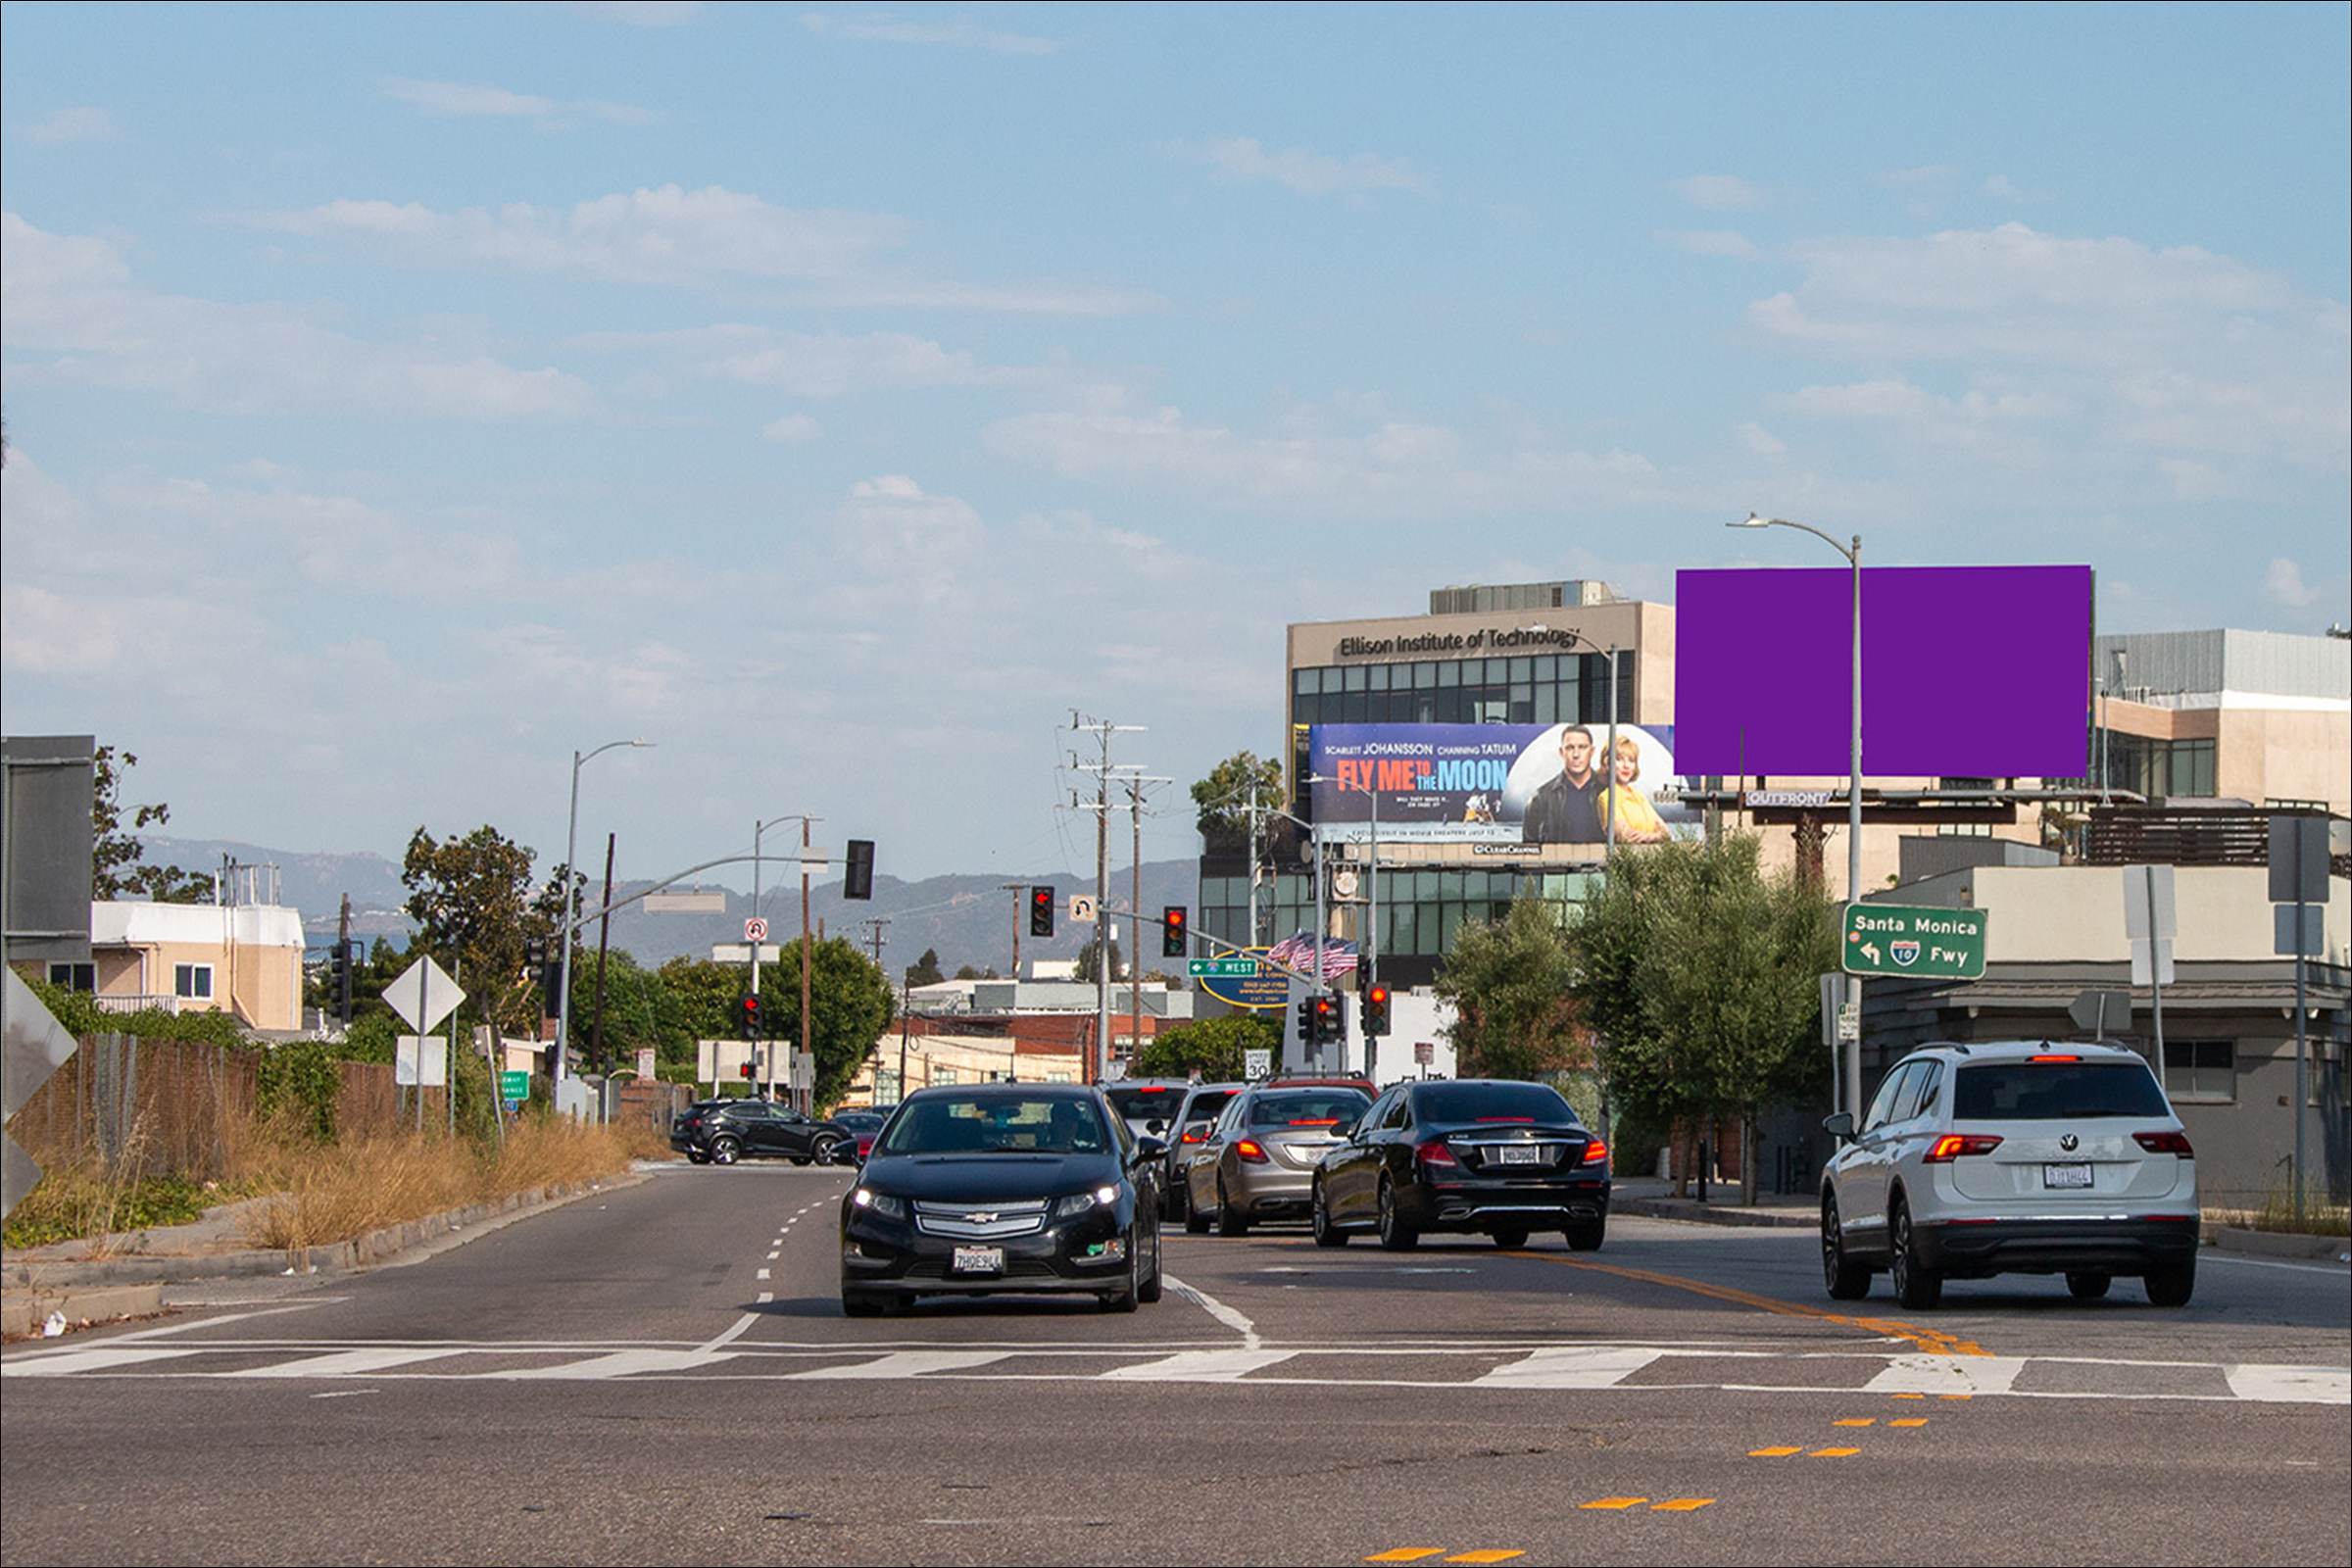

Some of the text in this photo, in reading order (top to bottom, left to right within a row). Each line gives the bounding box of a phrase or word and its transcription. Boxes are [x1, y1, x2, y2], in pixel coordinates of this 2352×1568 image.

[1341, 626, 1580, 656] Ellison Institute of Technology
[1325, 743, 1517, 756] SCARLETT JOHANSSON CHANNING TATUM
[1337, 760, 1507, 791] FLY ME TO THE MOON
[1748, 792, 1826, 805] OUTFRONT
[1855, 915, 1978, 935] Santa Monica
[1898, 947, 1968, 968] 10 Fwy
[1225, 963, 1252, 972] WEST
[1249, 1065, 1268, 1077] 30
